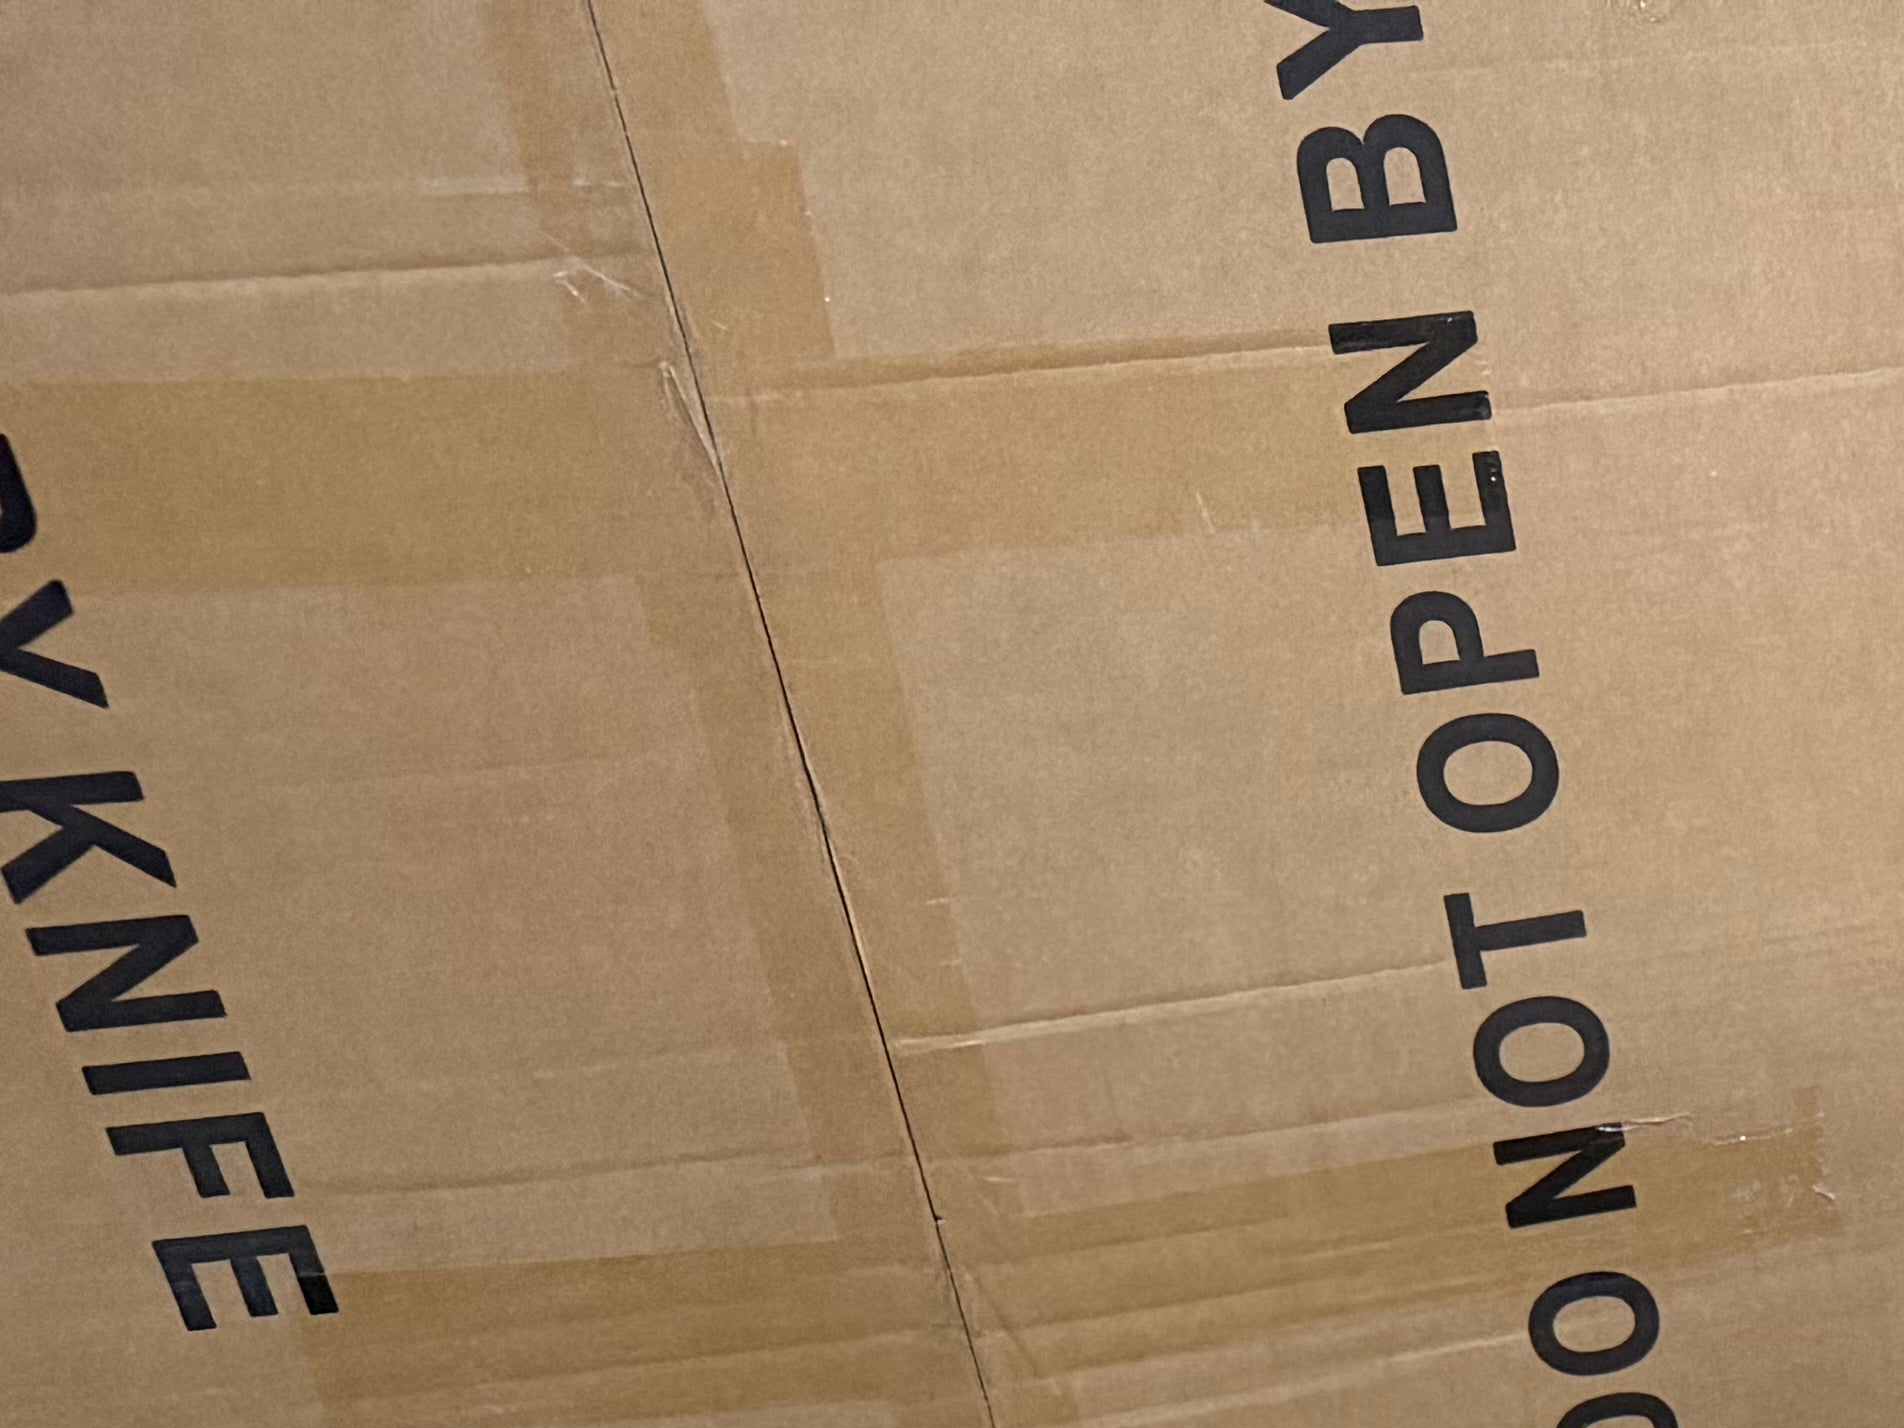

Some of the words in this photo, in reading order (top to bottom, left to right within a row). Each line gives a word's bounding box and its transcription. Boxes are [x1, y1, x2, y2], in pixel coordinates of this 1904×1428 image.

[1328, 311, 1559, 834] OPEN
[0, 771, 339, 1331] KNIFE
[1444, 893, 1637, 1230] NOT
